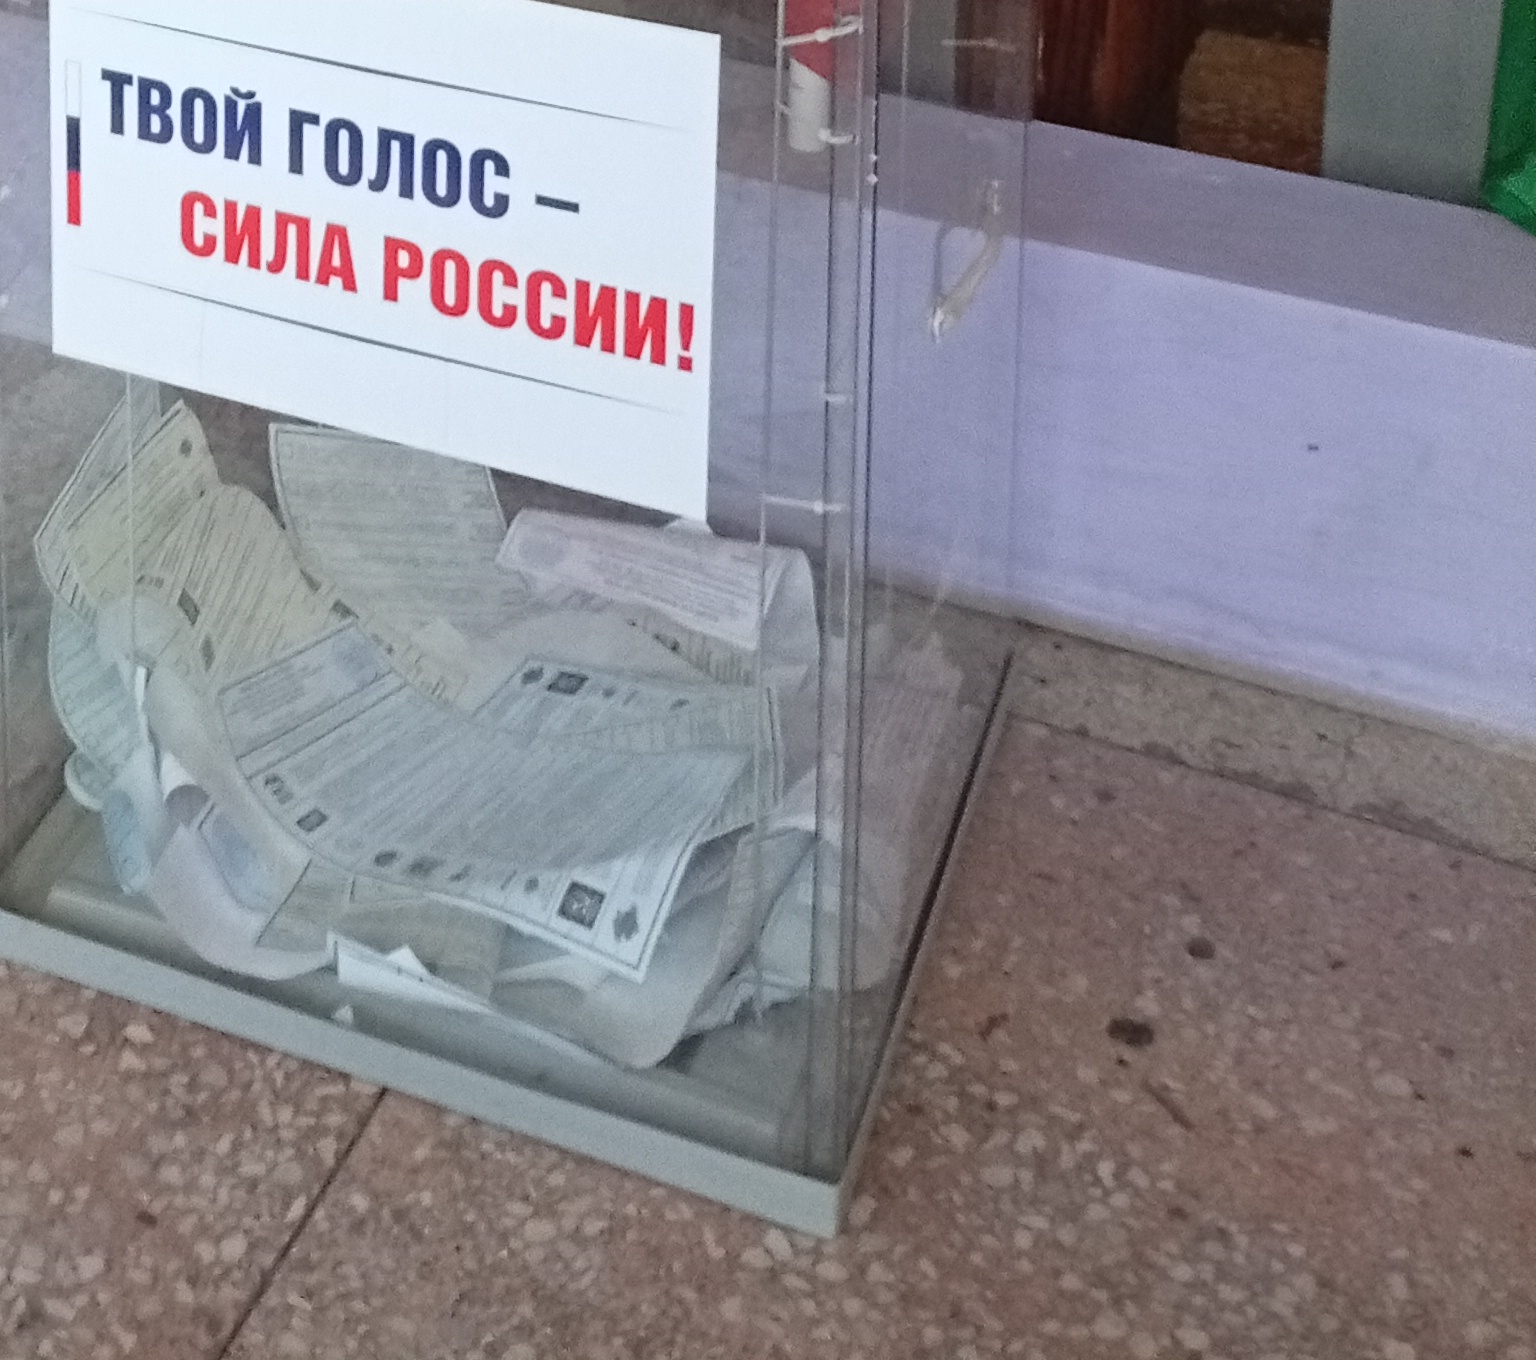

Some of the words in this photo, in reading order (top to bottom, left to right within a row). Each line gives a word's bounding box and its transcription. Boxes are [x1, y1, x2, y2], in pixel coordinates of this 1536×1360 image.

[101, 68, 262, 167] ТВОЙ
[288, 108, 510, 219] ГОЛОС
[180, 191, 358, 293] СИЛА
[383, 236, 695, 373] РОССИИ!
